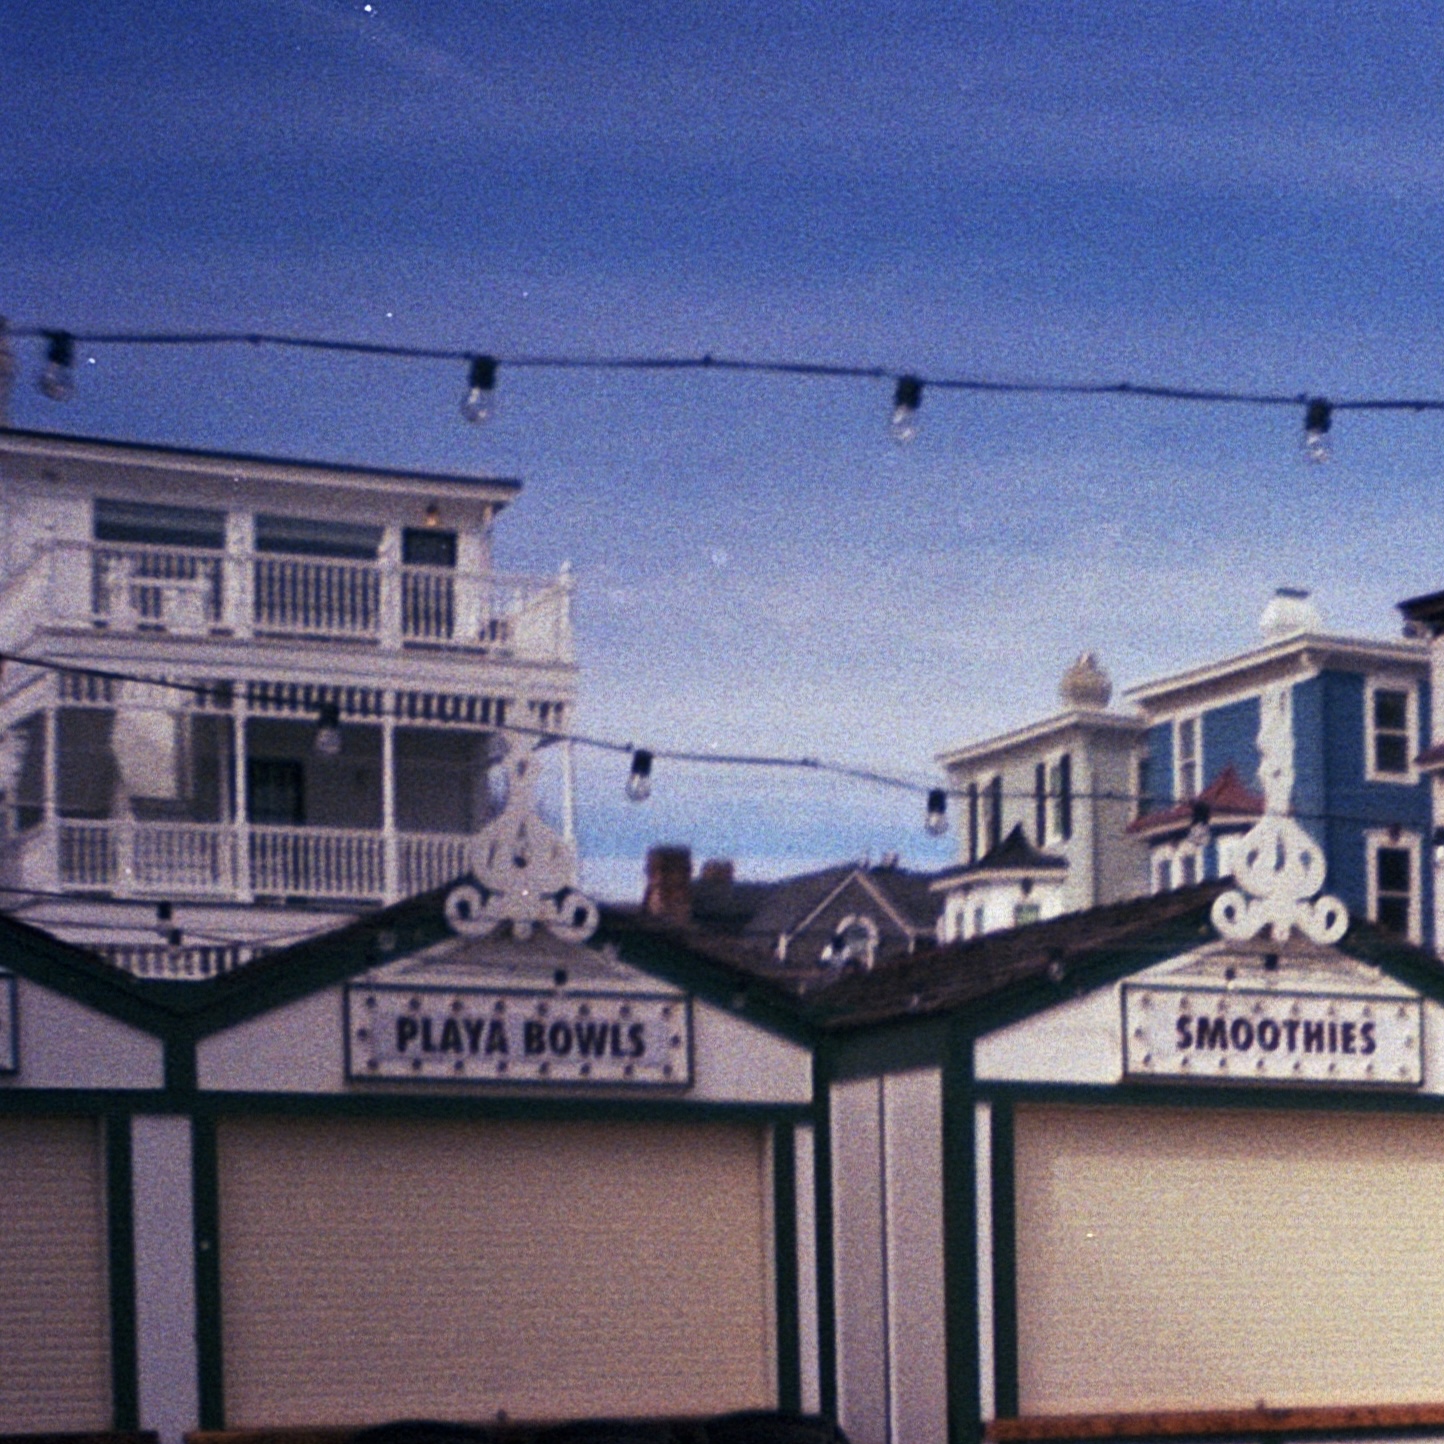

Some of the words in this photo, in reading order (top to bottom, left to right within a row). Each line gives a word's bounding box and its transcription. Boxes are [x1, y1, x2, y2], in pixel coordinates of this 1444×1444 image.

[396, 1016, 508, 1054] PLAYA
[523, 1020, 645, 1057] BOWLS
[1176, 1014, 1376, 1055] SMOOTHIES
